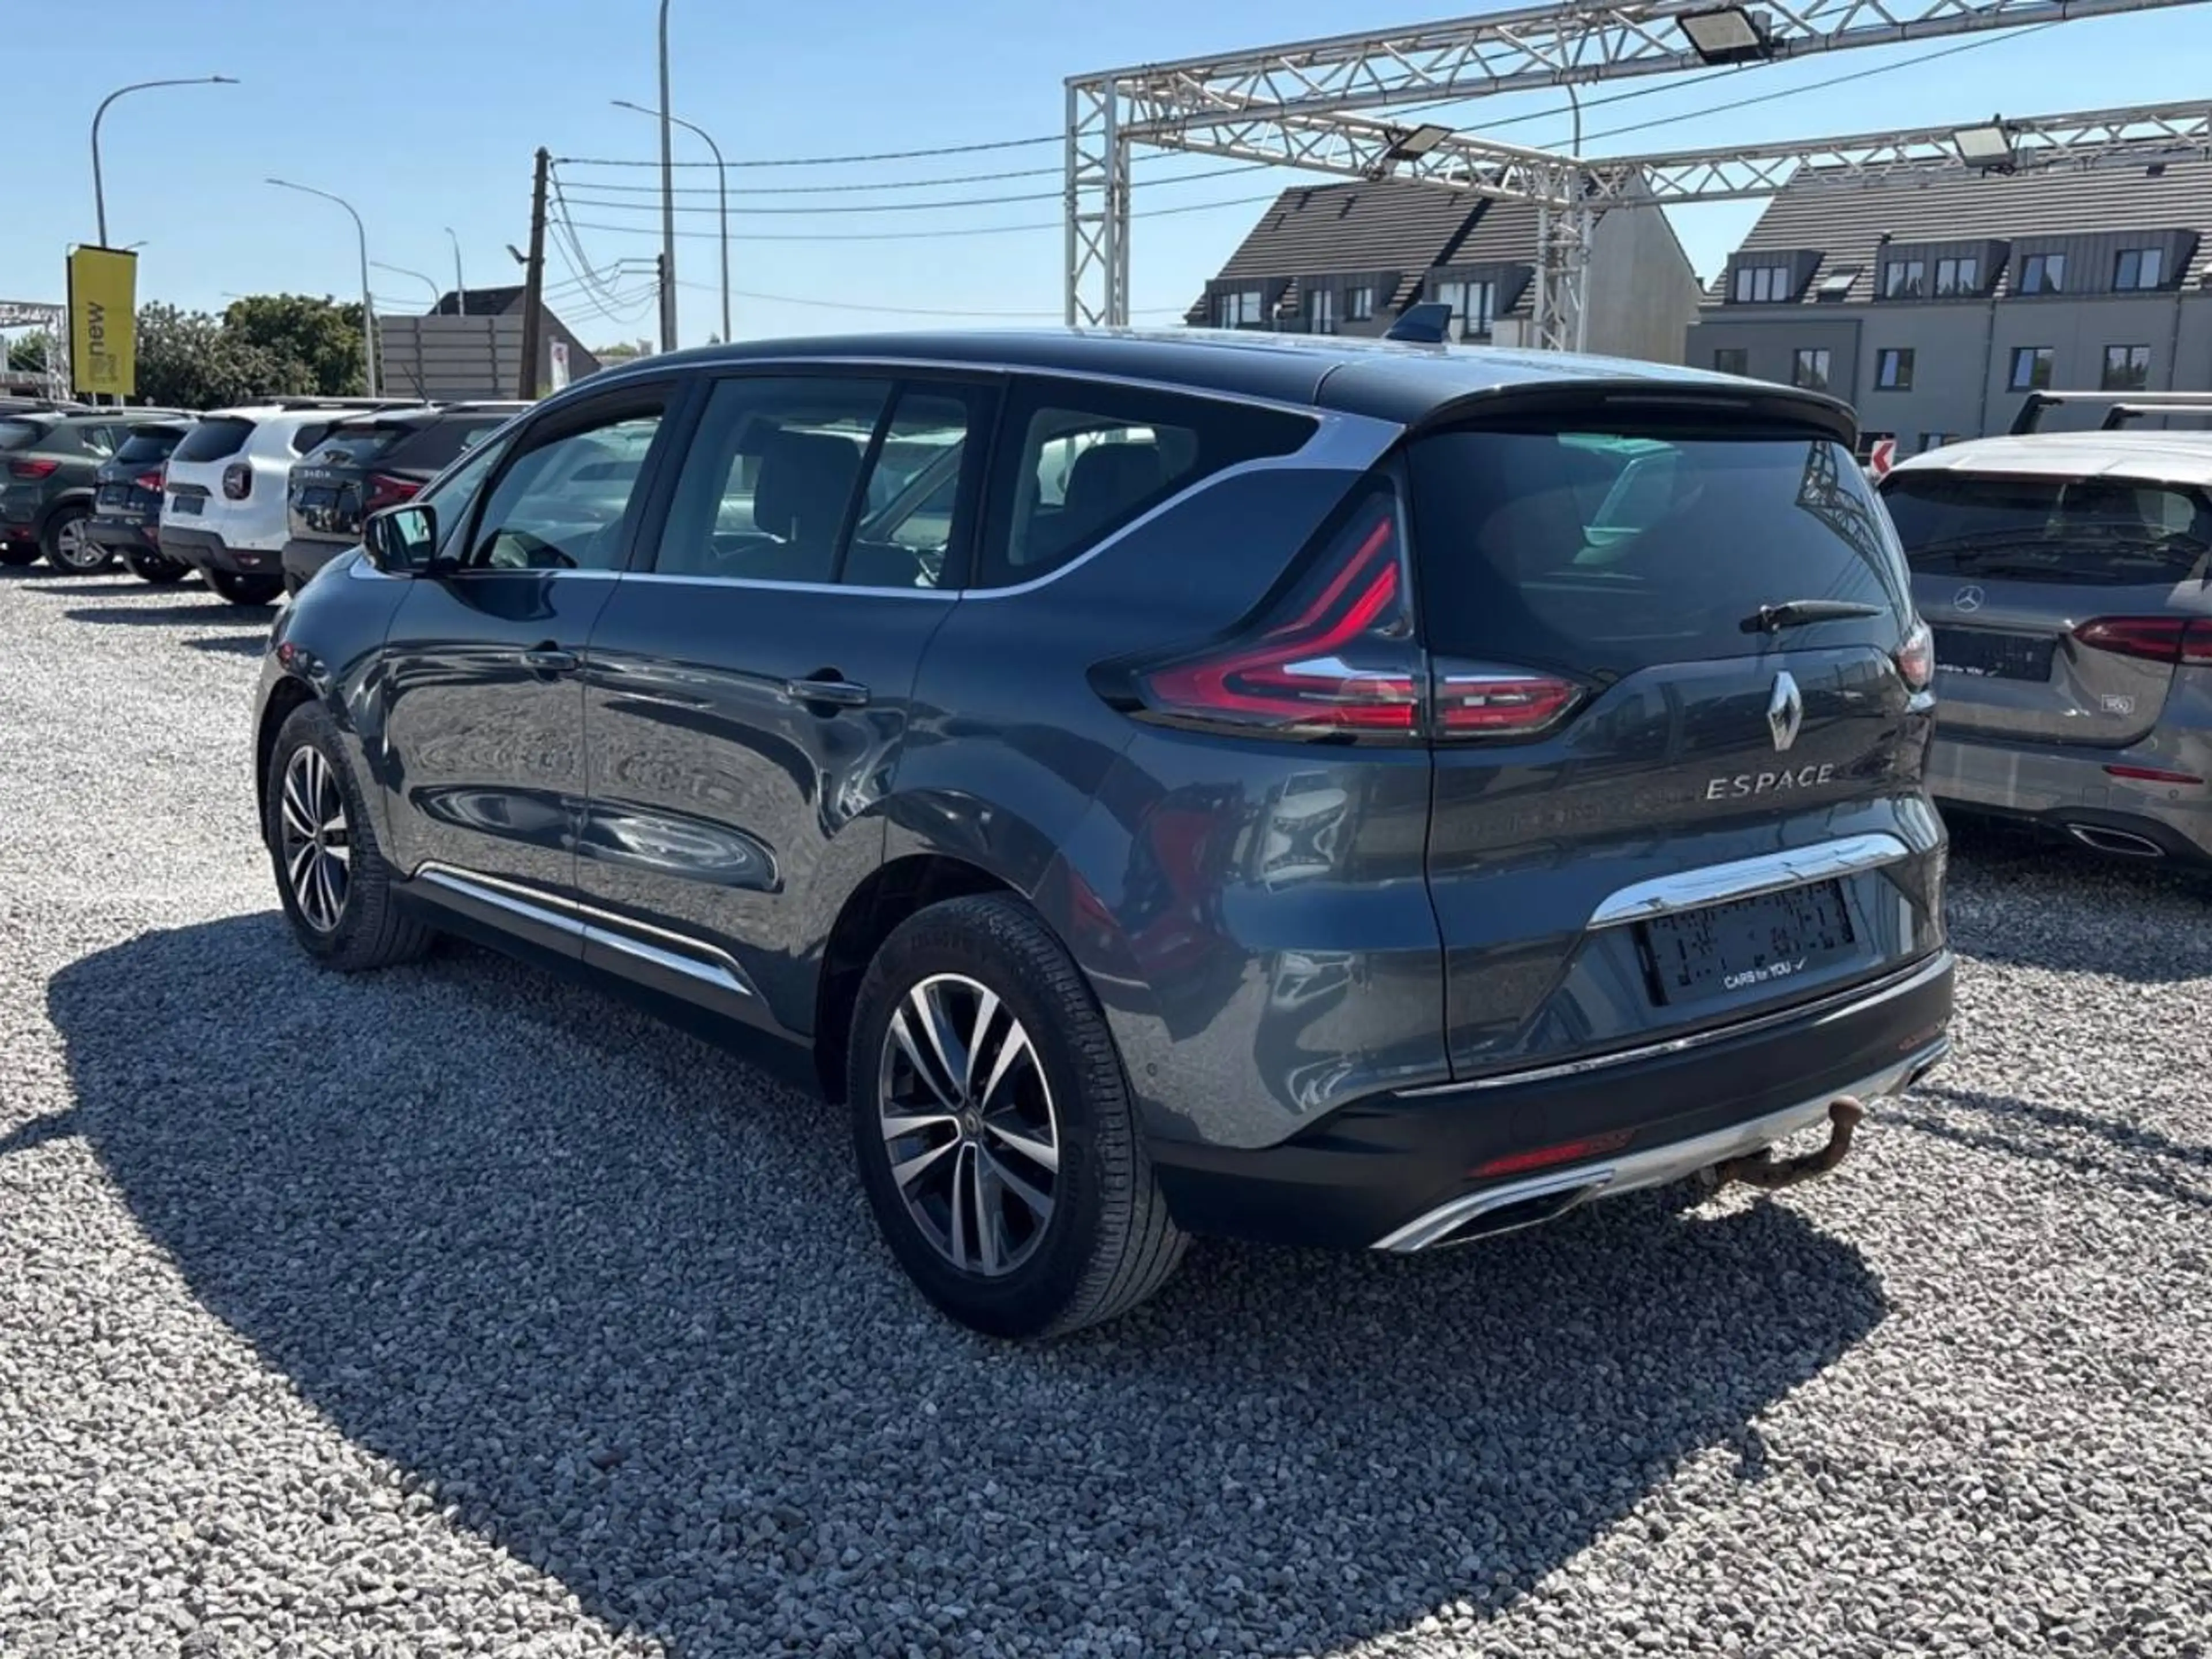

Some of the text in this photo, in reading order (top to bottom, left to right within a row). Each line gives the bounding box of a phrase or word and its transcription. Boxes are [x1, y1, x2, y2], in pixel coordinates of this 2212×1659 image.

[88, 301, 105, 356] new
[1706, 763, 1834, 800] ESPACE
[1768, 960, 1791, 978] YOU
